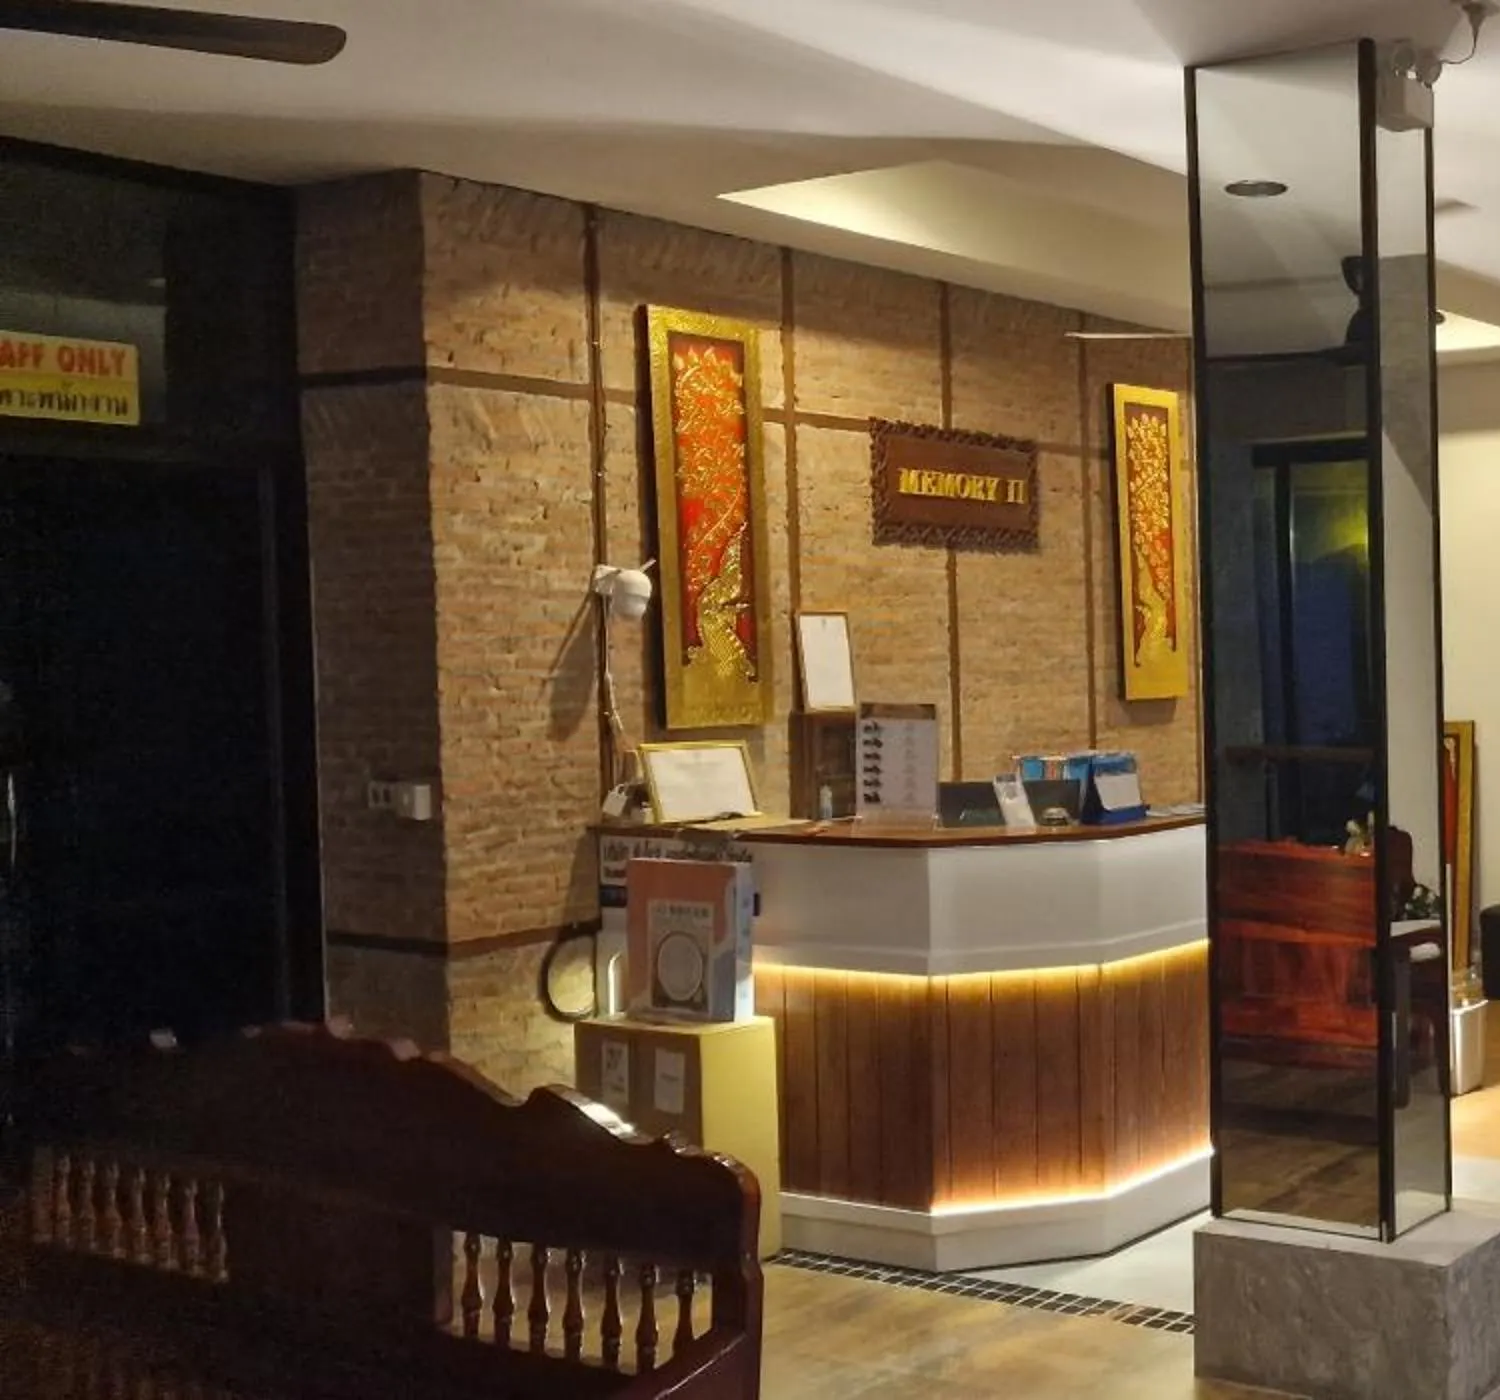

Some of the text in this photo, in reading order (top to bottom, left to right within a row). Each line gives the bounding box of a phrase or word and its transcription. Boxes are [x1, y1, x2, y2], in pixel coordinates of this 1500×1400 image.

[58, 345, 126, 376] ONLY
[898, 468, 1026, 505] MEMORY II
